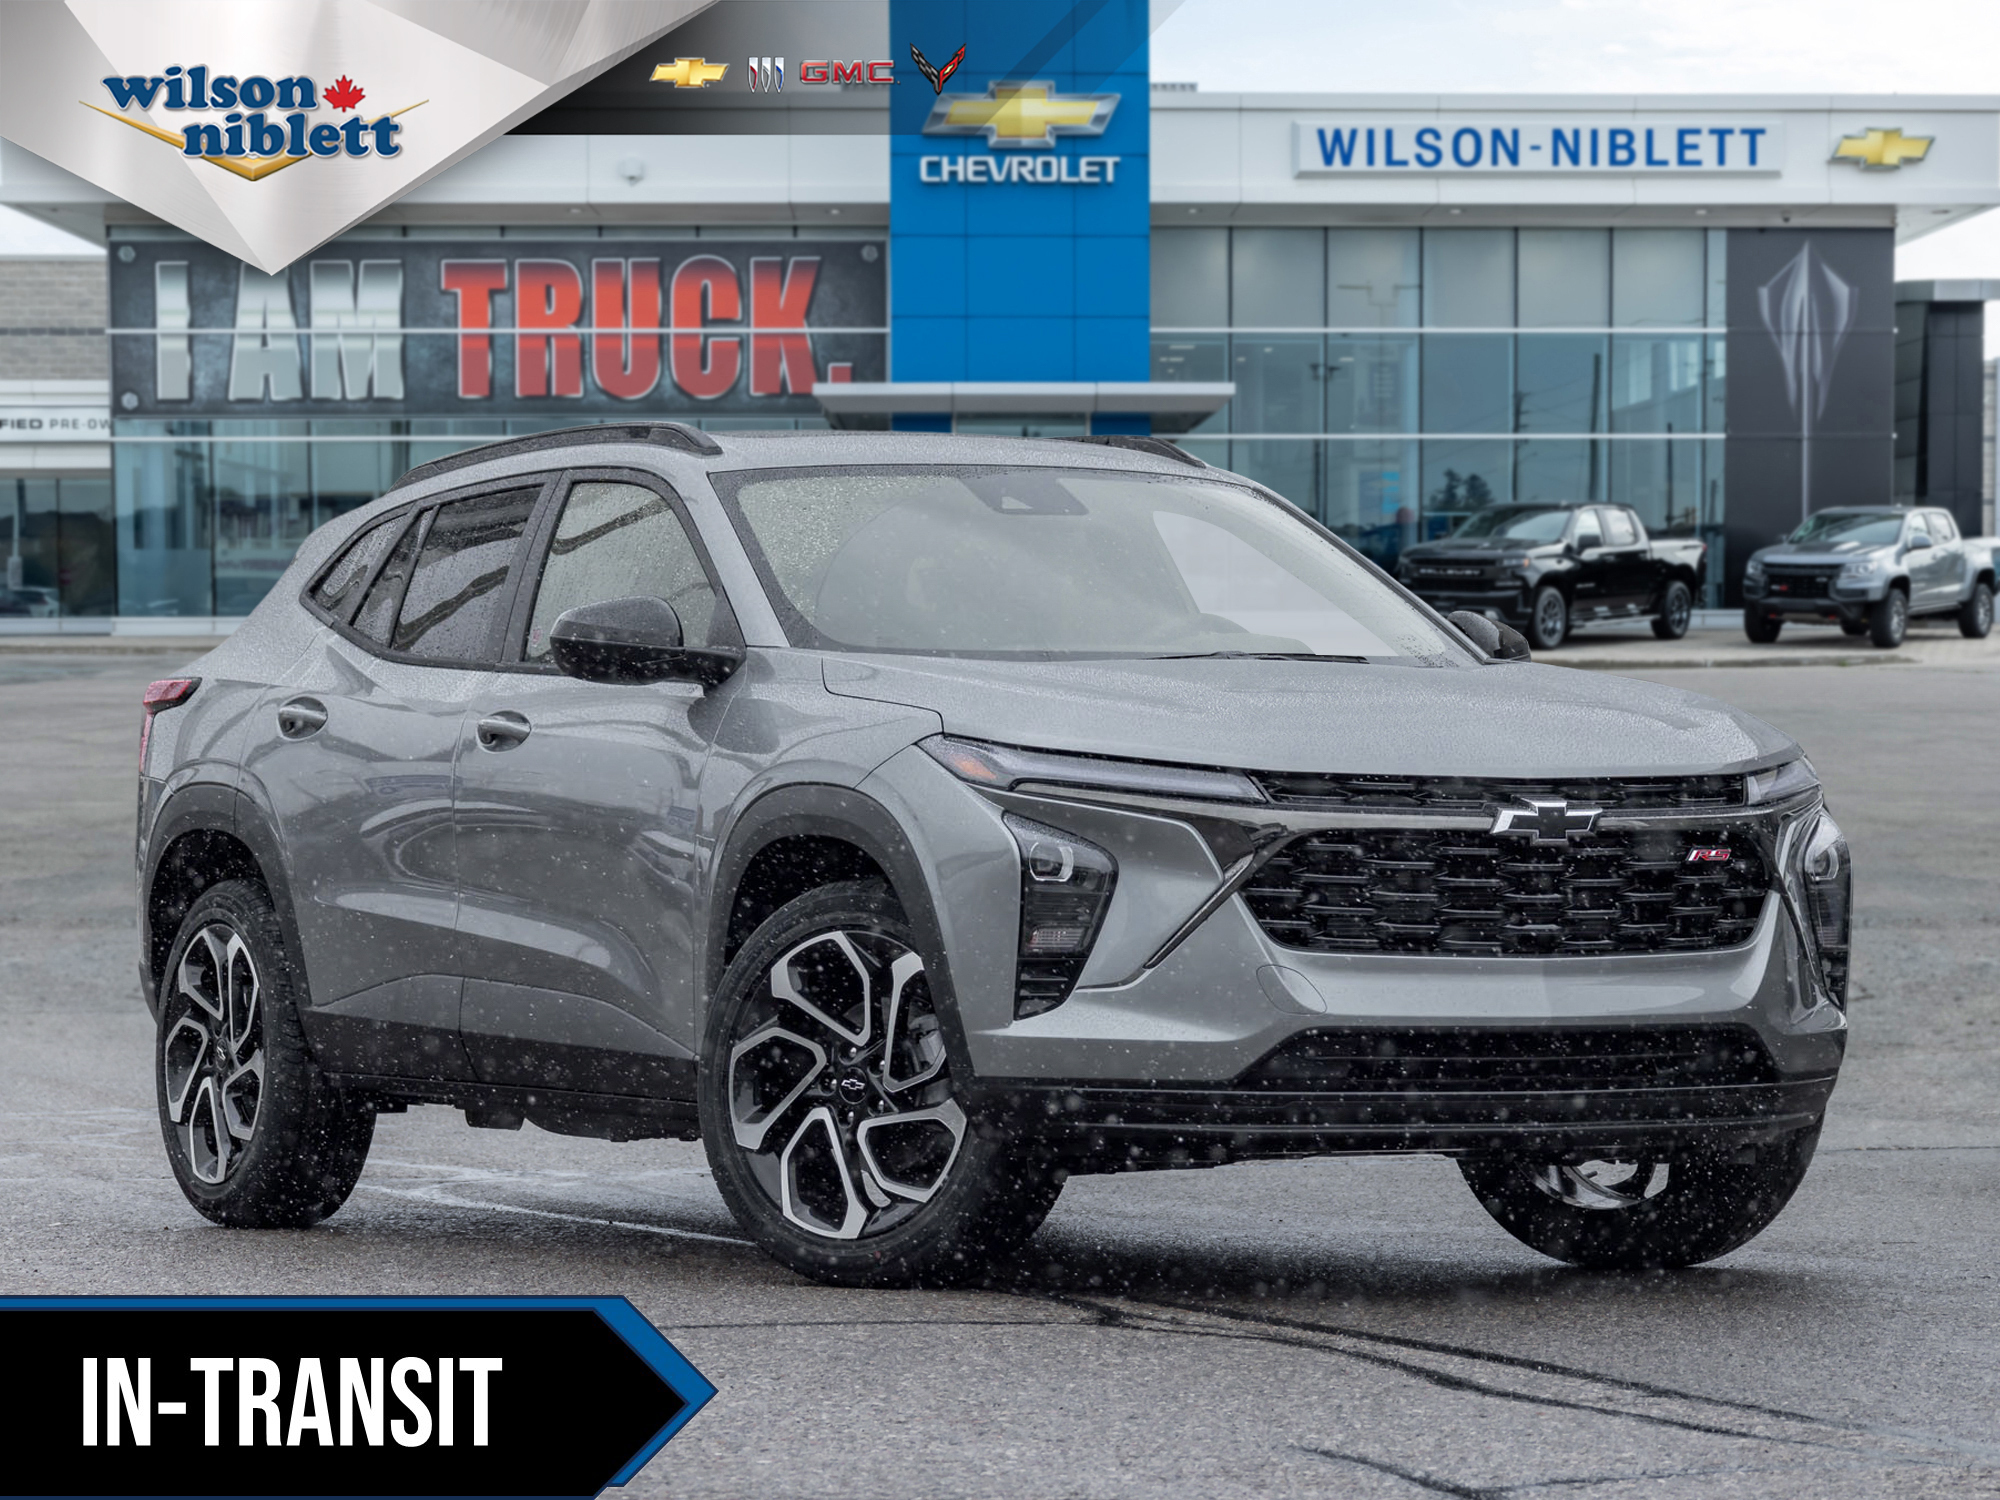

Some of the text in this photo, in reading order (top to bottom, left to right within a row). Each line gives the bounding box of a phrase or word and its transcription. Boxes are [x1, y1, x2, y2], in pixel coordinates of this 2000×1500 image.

[1316, 127, 1767, 168] WILSON-NIBLETT
[919, 155, 1121, 183] CHEVROLET
[155, 255, 853, 400] I AM TRUCK.
[1686, 848, 1732, 862] RS
